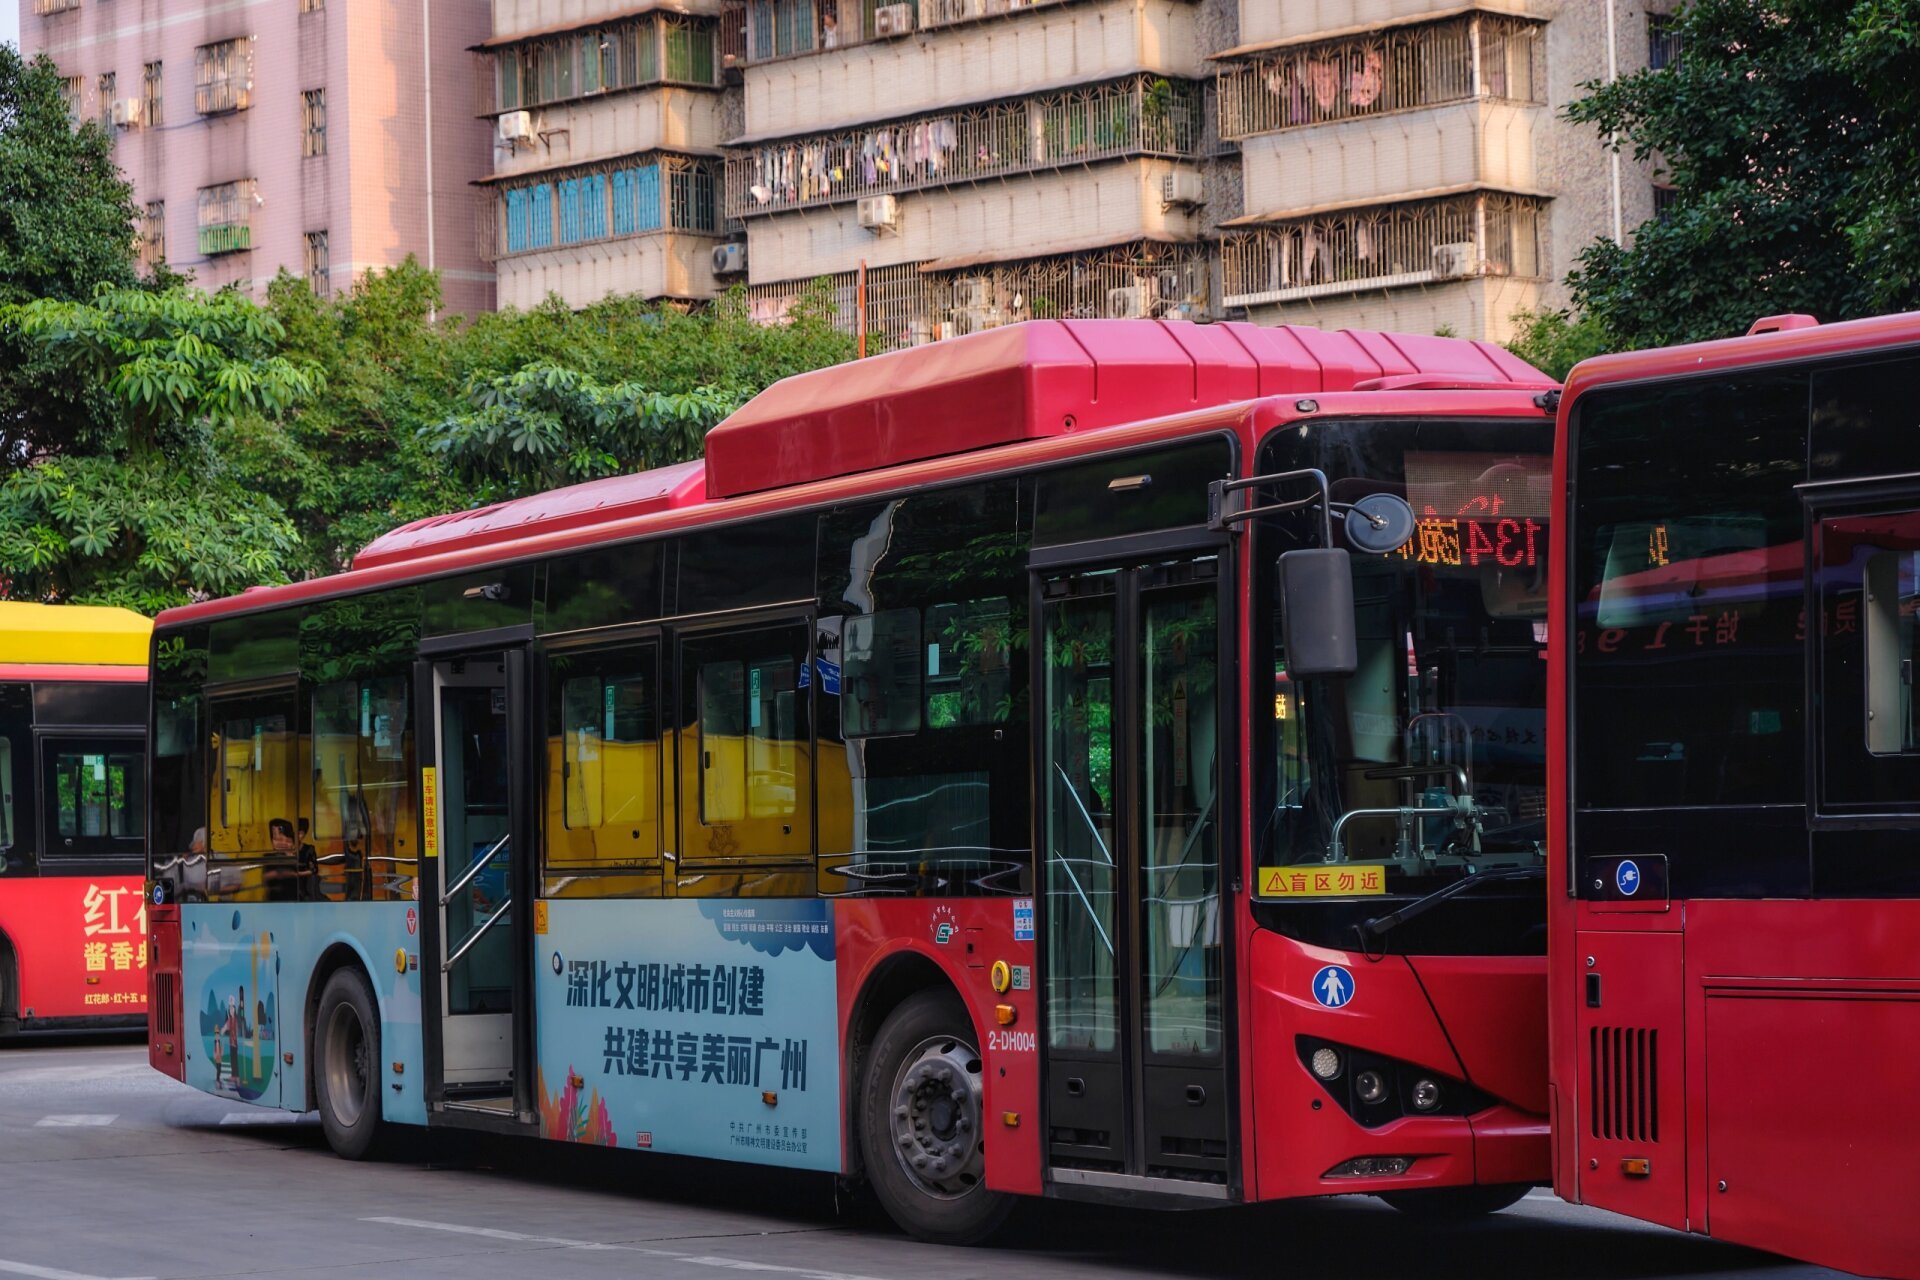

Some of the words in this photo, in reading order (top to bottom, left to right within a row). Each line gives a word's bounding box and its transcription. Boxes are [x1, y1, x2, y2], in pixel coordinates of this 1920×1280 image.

[424, 774, 436, 850] 下车请注意来车
[1288, 872, 1380, 892] 盲区勿近
[83, 883, 147, 937] 红
[566, 960, 765, 1016] 深化文明城市创建
[603, 1026, 808, 1092] 共建共享美丽广州
[988, 1030, 1036, 1053] 2-DH004
